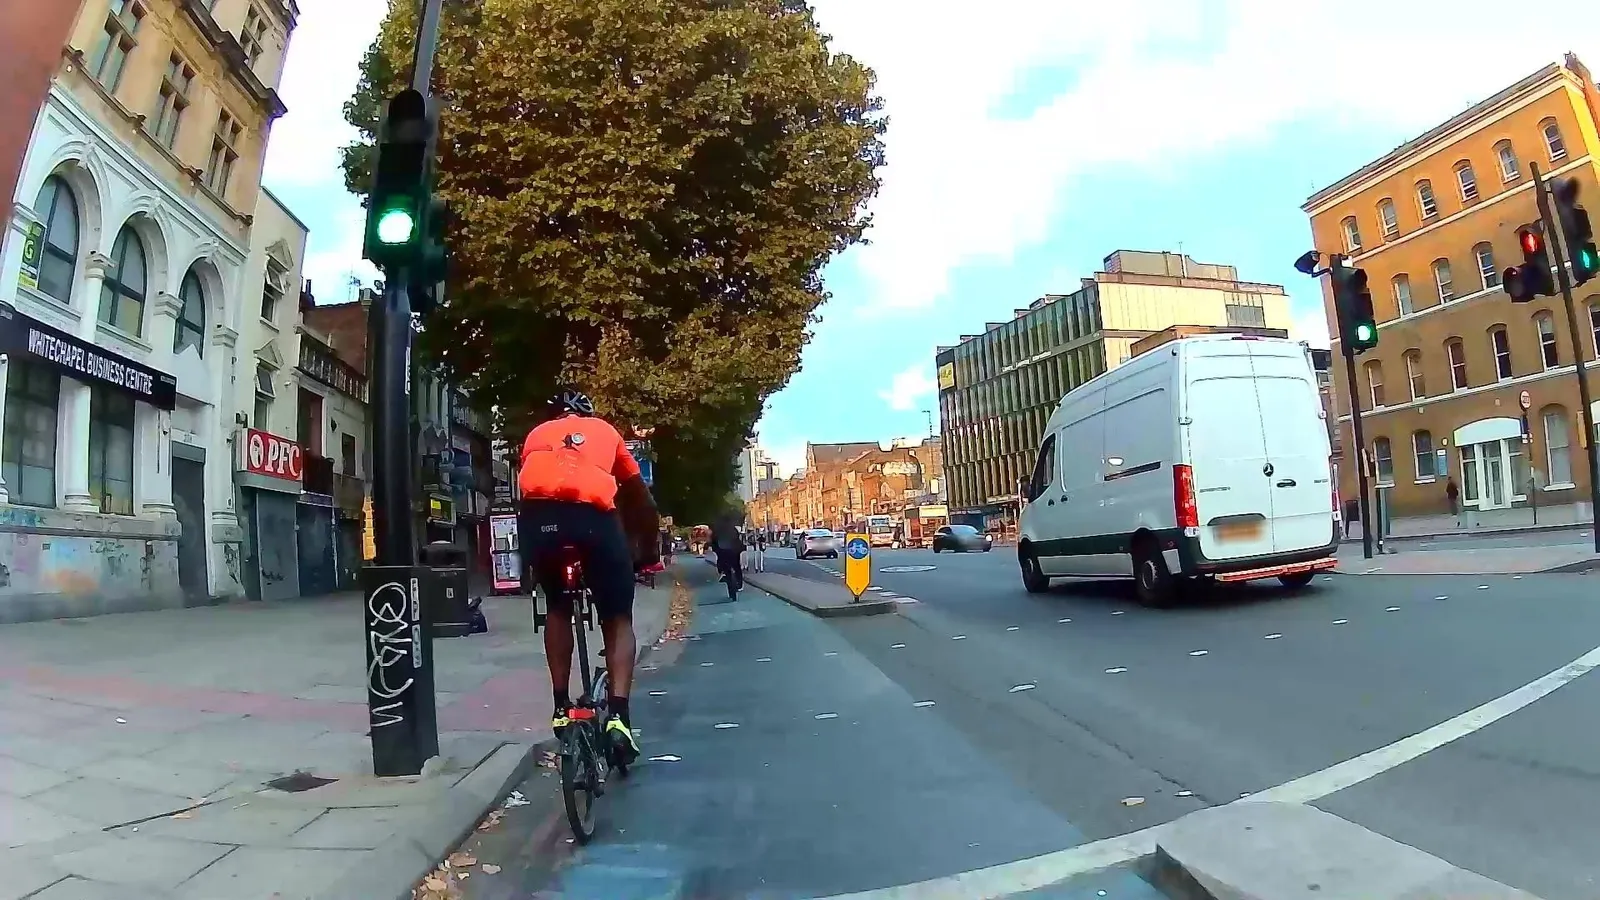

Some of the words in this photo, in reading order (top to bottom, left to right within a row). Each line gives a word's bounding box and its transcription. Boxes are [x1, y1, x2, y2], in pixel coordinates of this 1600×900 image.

[28, 328, 86, 372] WHITECHAPEL
[87, 353, 124, 386] BUSINESS
[125, 367, 153, 395] CENTRE
[265, 438, 301, 477] PFC
